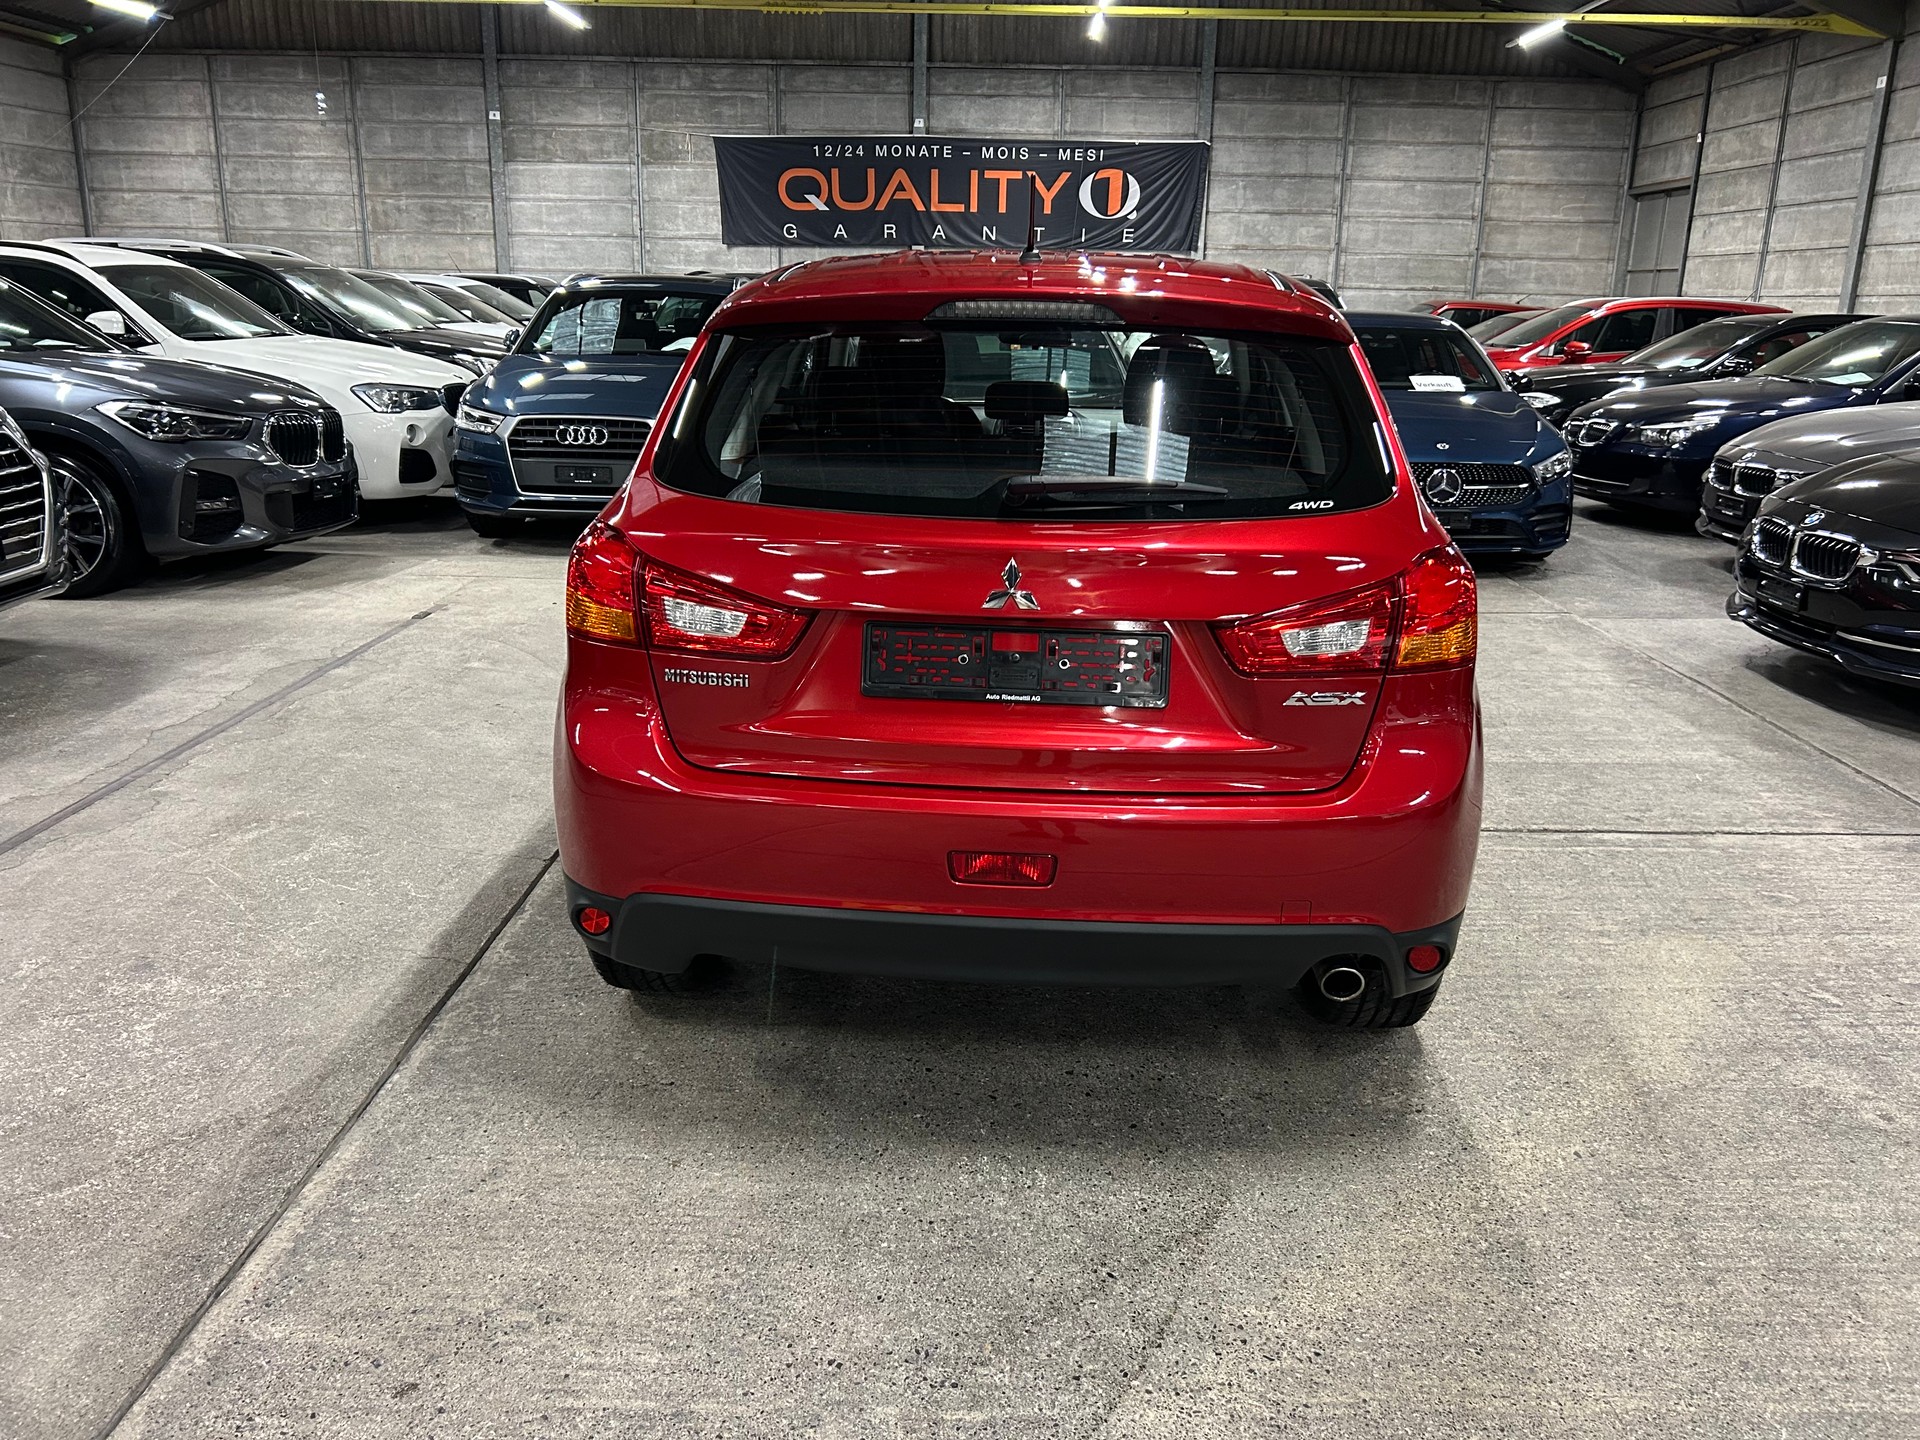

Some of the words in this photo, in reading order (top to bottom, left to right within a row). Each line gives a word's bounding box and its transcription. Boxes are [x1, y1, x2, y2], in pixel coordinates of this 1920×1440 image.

[813, 145, 864, 157] 12/24
[875, 145, 954, 158] MONATE
[981, 147, 1030, 160] MOIS
[1058, 149, 1104, 162] MESI
[778, 168, 1072, 215] QUALITY
[783, 223, 1135, 243] GARANTIE
[1288, 500, 1334, 510] 4WD
[664, 668, 749, 688] MITSUBISHI
[1282, 691, 1368, 706] ASX
